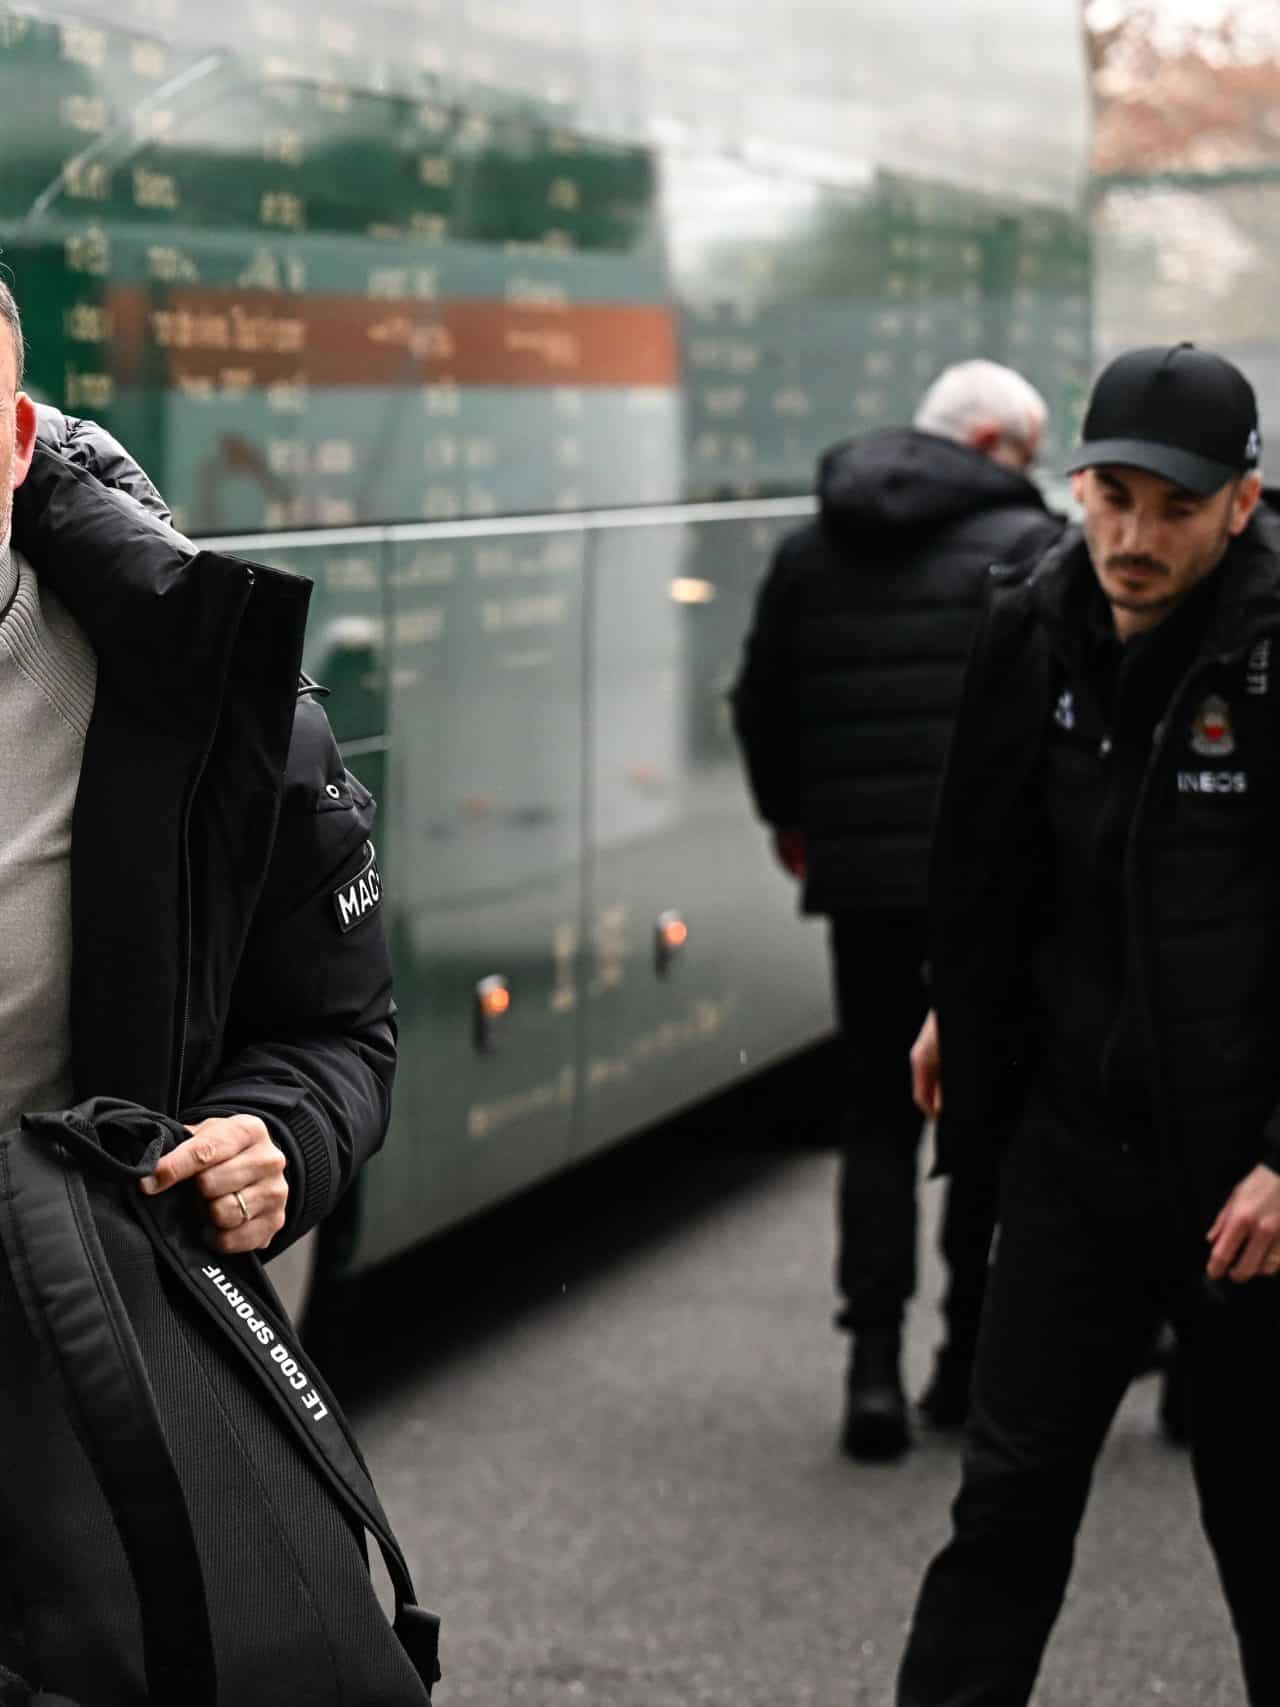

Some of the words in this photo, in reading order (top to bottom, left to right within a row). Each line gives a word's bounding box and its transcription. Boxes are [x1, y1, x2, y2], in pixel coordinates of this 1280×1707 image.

[1177, 771, 1247, 793] INEOS
[338, 868, 380, 925] MAC
[201, 1265, 275, 1345] SPORTIF
[270, 1343, 307, 1390] COQ
[301, 1389, 328, 1421] LE
